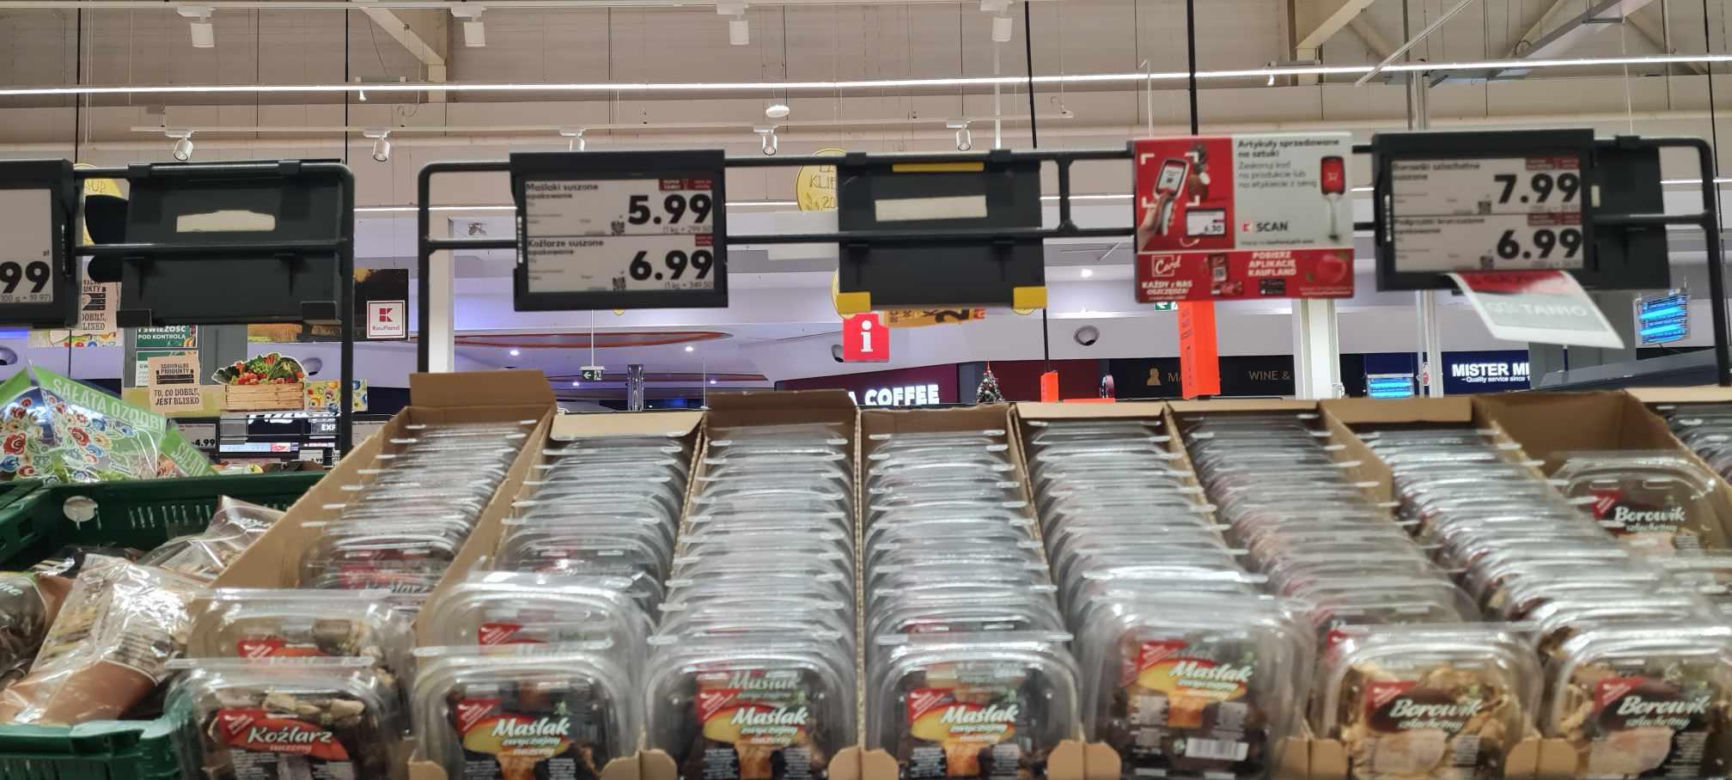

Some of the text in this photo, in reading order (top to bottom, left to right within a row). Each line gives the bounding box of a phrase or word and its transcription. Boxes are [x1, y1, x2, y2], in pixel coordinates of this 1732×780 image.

[1494, 173, 1579, 204] 7.99
[628, 193, 712, 225] 5.99
[1256, 221, 1288, 232] SCAN
[1497, 228, 1582, 260] 6.99
[1252, 251, 1292, 259] POBIERZ
[629, 250, 713, 281] 6.99
[1155, 256, 1181, 275] Card
[1247, 268, 1297, 277] KAUFLAND
[1249, 370, 1291, 382] WINE &
[1452, 362, 1509, 378] MISTER
[53, 378, 107, 413] SAŁATA
[155, 398, 172, 406] JEST
[864, 384, 940, 406] COFFEE
[1615, 505, 1686, 522] Borowik
[1168, 660, 1254, 683] Maślak
[940, 704, 1020, 724] Maślak
[1389, 697, 1483, 718] Borowik
[1617, 694, 1712, 716] Borowik
[731, 706, 809, 725] Maślak
[248, 725, 334, 745] Koźlarz
[491, 717, 571, 737] Maślak
